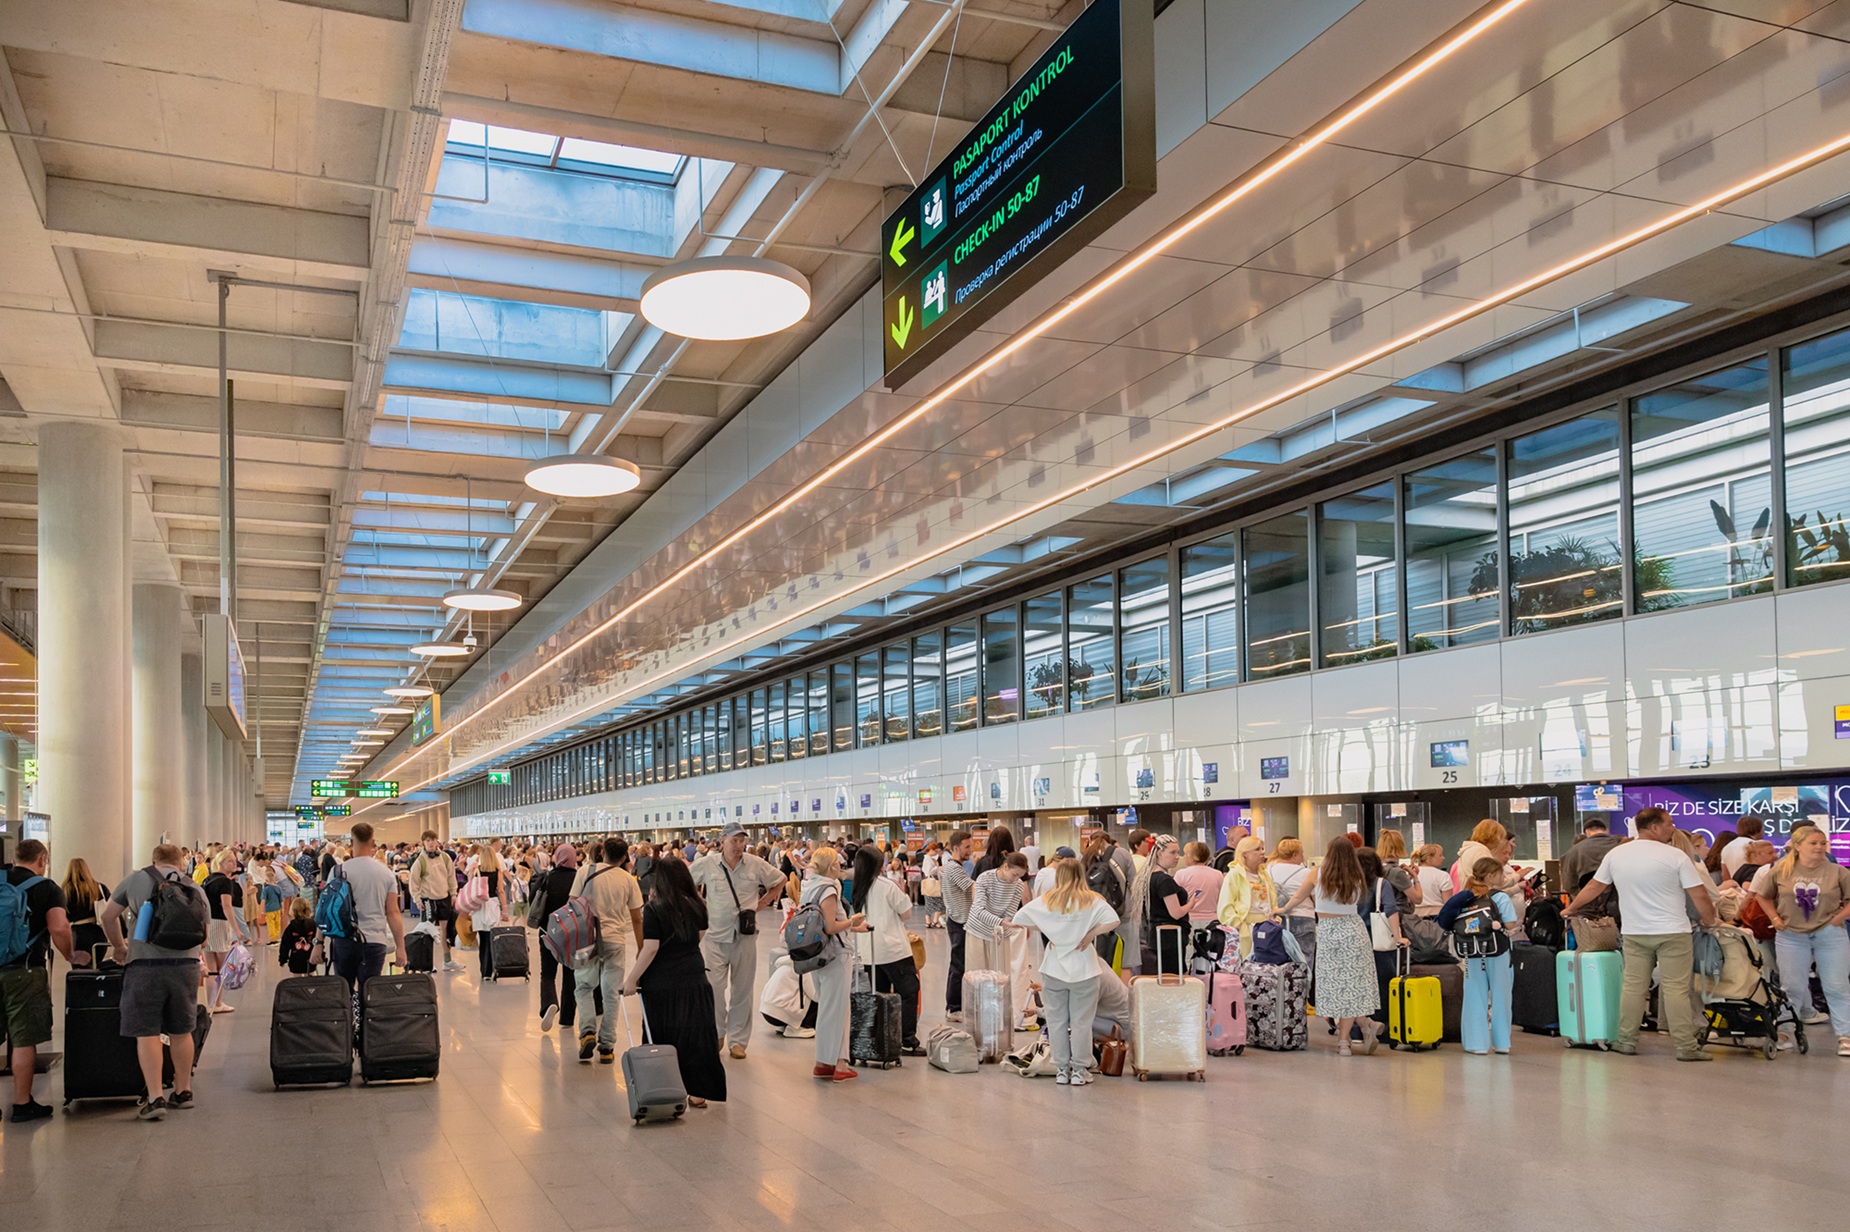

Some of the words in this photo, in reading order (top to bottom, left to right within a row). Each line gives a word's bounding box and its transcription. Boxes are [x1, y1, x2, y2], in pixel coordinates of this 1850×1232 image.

[953, 107, 1010, 179] PASAPORT
[1013, 45, 1074, 119] KONTROL
[954, 155, 989, 200] Passport
[991, 119, 1023, 163] Control
[955, 161, 1002, 218] Паспортный
[1003, 128, 1043, 172] контроль
[954, 206, 1004, 264] CHECK-IN
[1007, 174, 1040, 218] 50-87
[955, 264, 994, 304] Проверка
[995, 215, 1052, 275] регистрации
[1054, 185, 1085, 223] 50-87
[1553, 763, 1572, 777] 24
[1689, 754, 1711, 769] 23
[1442, 771, 1458, 783] 25
[1140, 791, 1149, 801] 29
[1269, 782, 1280, 793] 27
[1683, 801, 1705, 816] DE
[1708, 798, 1744, 815] SİZE
[1747, 798, 1799, 816] KARŞI
